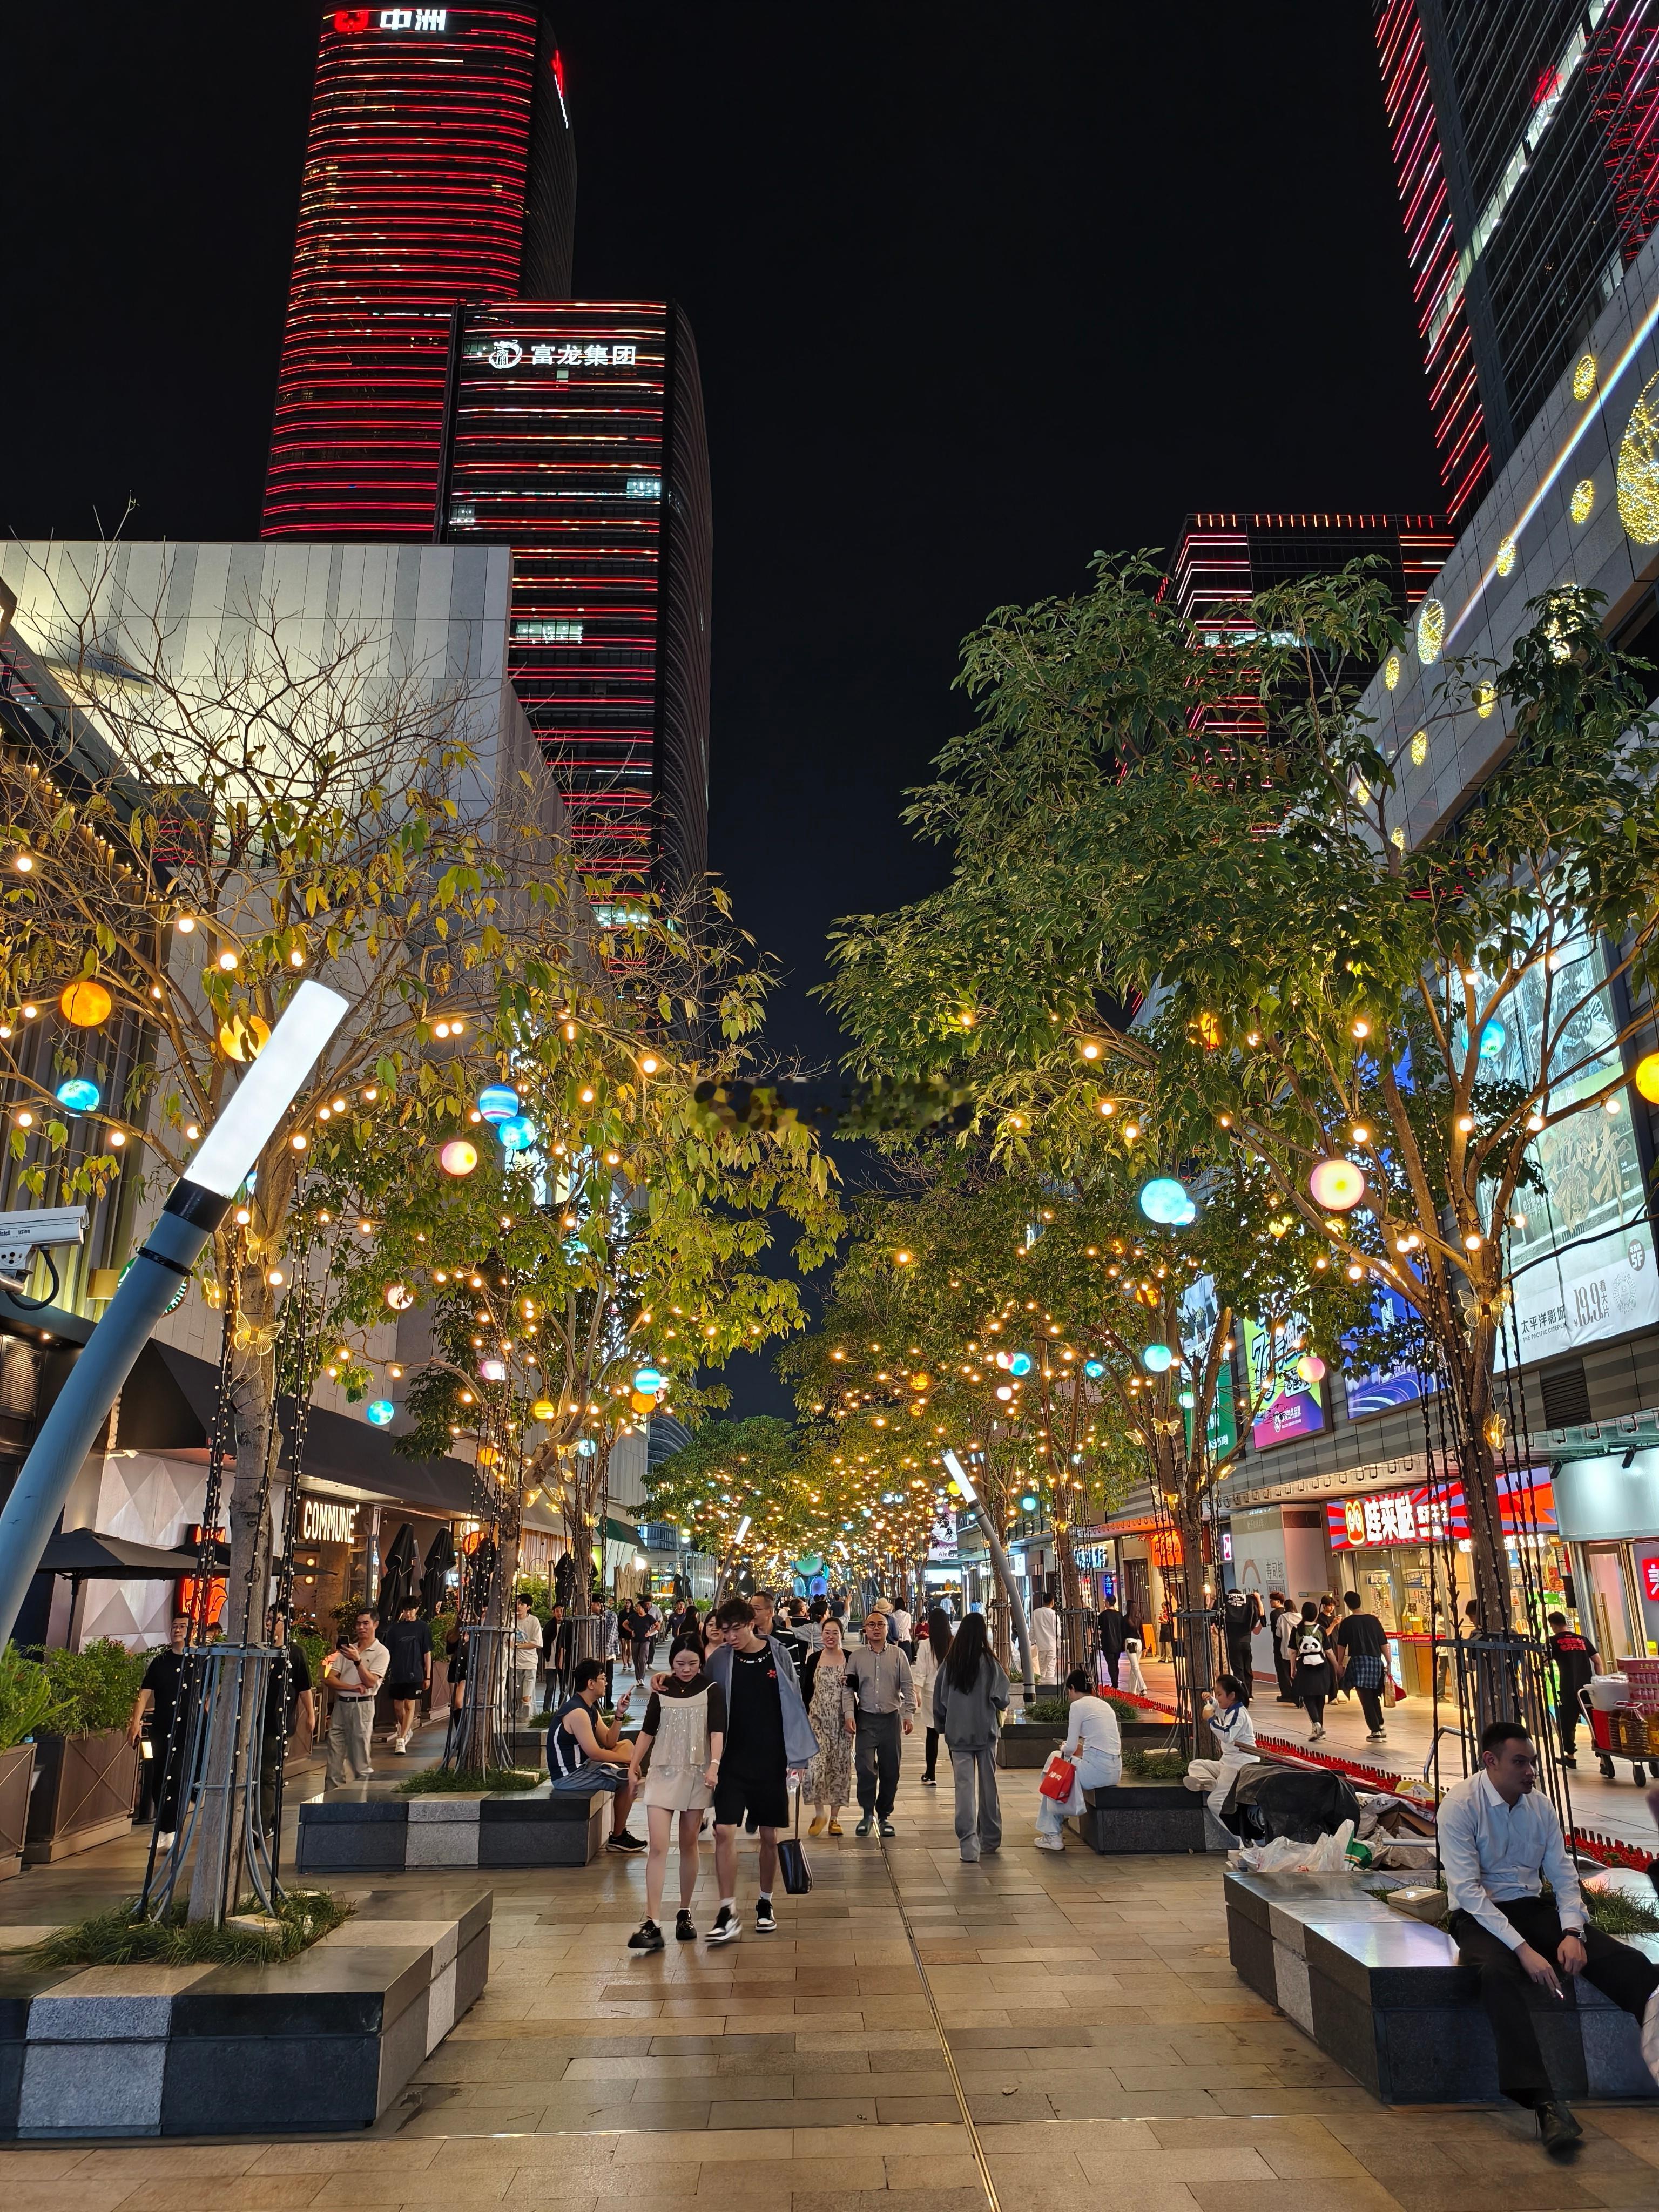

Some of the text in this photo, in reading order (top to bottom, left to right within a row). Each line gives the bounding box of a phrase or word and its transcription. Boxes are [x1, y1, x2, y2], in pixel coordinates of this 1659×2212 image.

[379, 9, 447, 31] 中洲
[530, 344, 637, 367] 富龙集团
[1631, 1250, 1643, 1269] 5F
[1599, 1279, 1609, 1318] 看大片
[1522, 1335, 1530, 1343] THE
[1531, 1329, 1548, 1340] PACIFIC
[304, 1501, 356, 1545] COMMUNE
